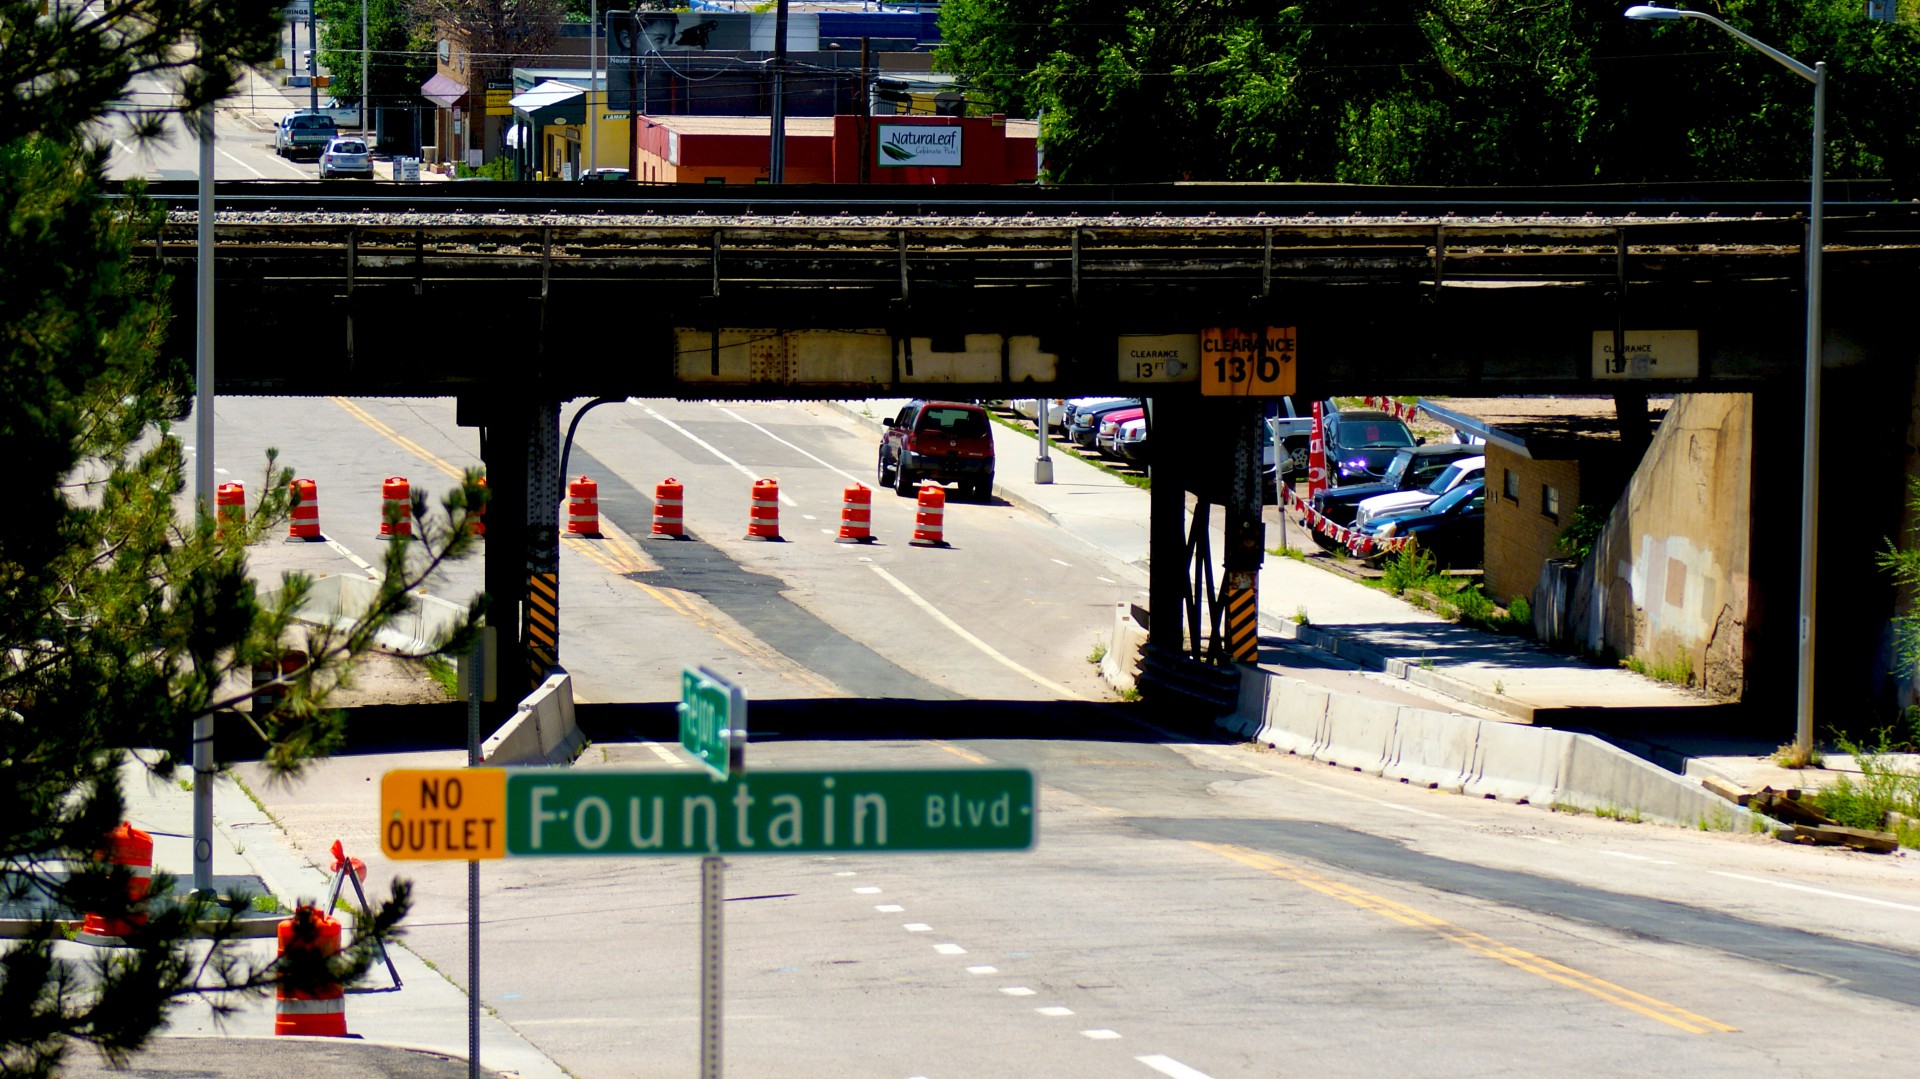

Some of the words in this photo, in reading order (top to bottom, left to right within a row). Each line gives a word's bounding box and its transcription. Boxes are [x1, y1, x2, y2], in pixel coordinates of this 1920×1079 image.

[1203, 338, 1295, 353] CLEARANCE
[1604, 344, 1652, 353] CLRANCE
[1130, 350, 1179, 358] CLEARANCE
[1136, 362, 1153, 378] 13
[420, 777, 464, 811] NO
[530, 776, 888, 848] Fountain
[925, 792, 1010, 828] Blvd
[387, 817, 496, 851] OUTLET
